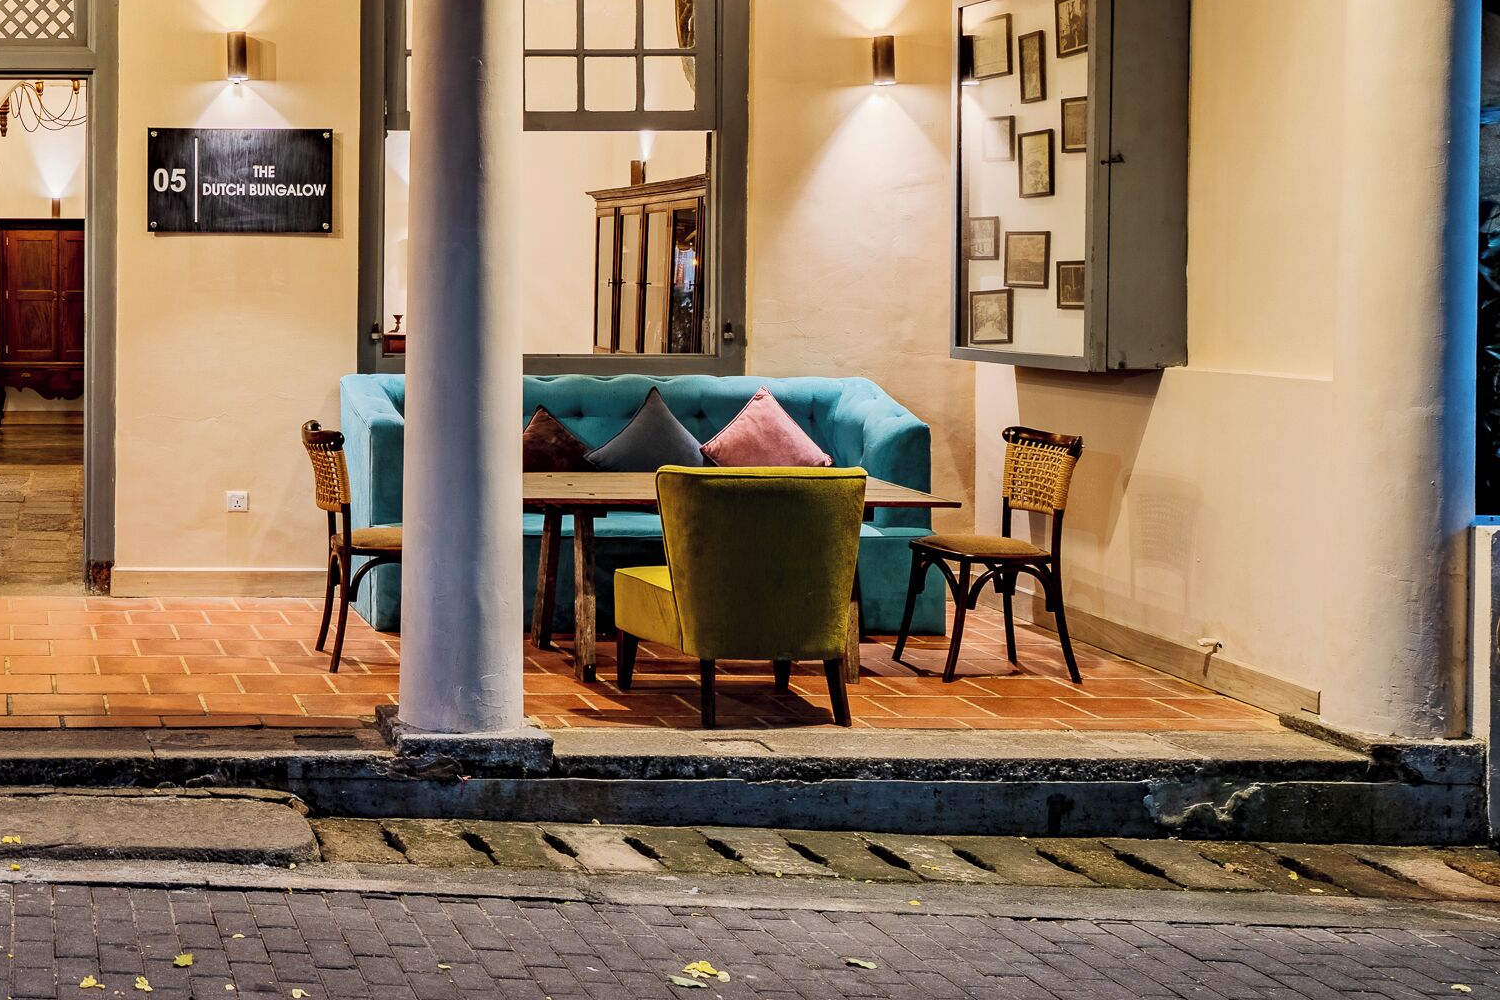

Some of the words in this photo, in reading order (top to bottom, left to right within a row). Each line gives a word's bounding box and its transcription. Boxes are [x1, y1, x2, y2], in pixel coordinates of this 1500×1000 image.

[252, 165, 276, 178] THE
[153, 168, 187, 193] 05
[202, 183, 246, 196] DUTCH
[249, 183, 327, 197] BUNGALOW
